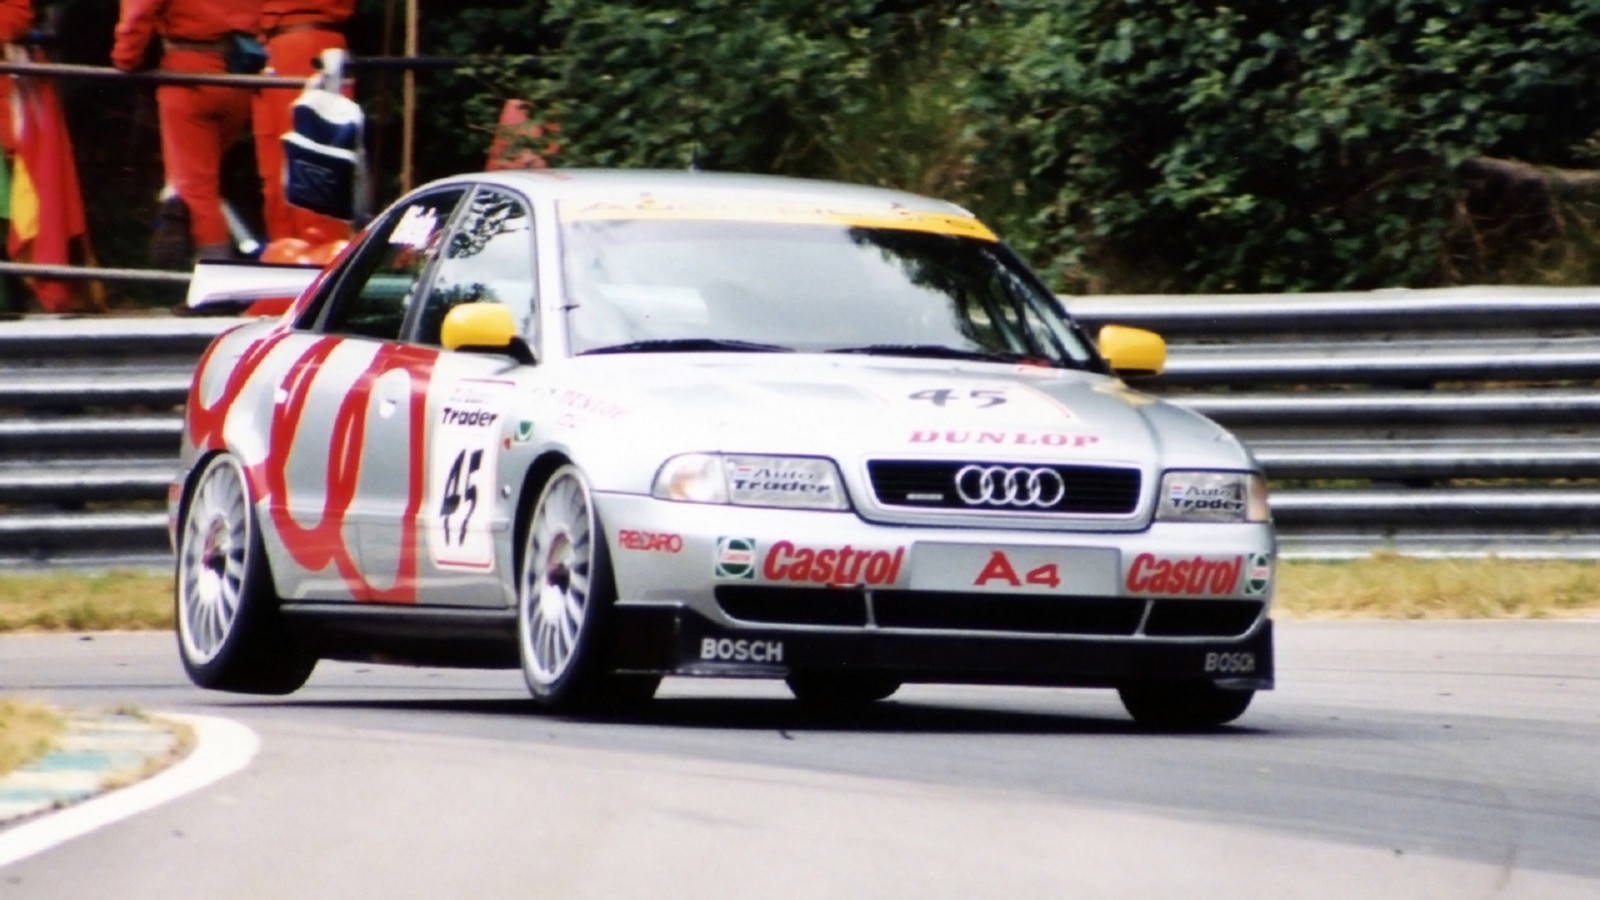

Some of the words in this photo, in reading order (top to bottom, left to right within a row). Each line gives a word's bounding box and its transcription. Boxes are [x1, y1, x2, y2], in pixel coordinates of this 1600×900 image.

[908, 388, 1008, 409] 45
[441, 407, 498, 427] Trader
[907, 430, 1100, 447] DUNLOP
[753, 468, 816, 480] Auto
[734, 480, 831, 493] Trader
[1184, 485, 1233, 497] Auto
[439, 449, 484, 547] 45
[1170, 497, 1244, 511] Trader
[763, 540, 905, 585] Castrol
[973, 550, 1061, 588] A4
[1125, 553, 1243, 595] Castrol
[700, 637, 784, 662] BOSCH
